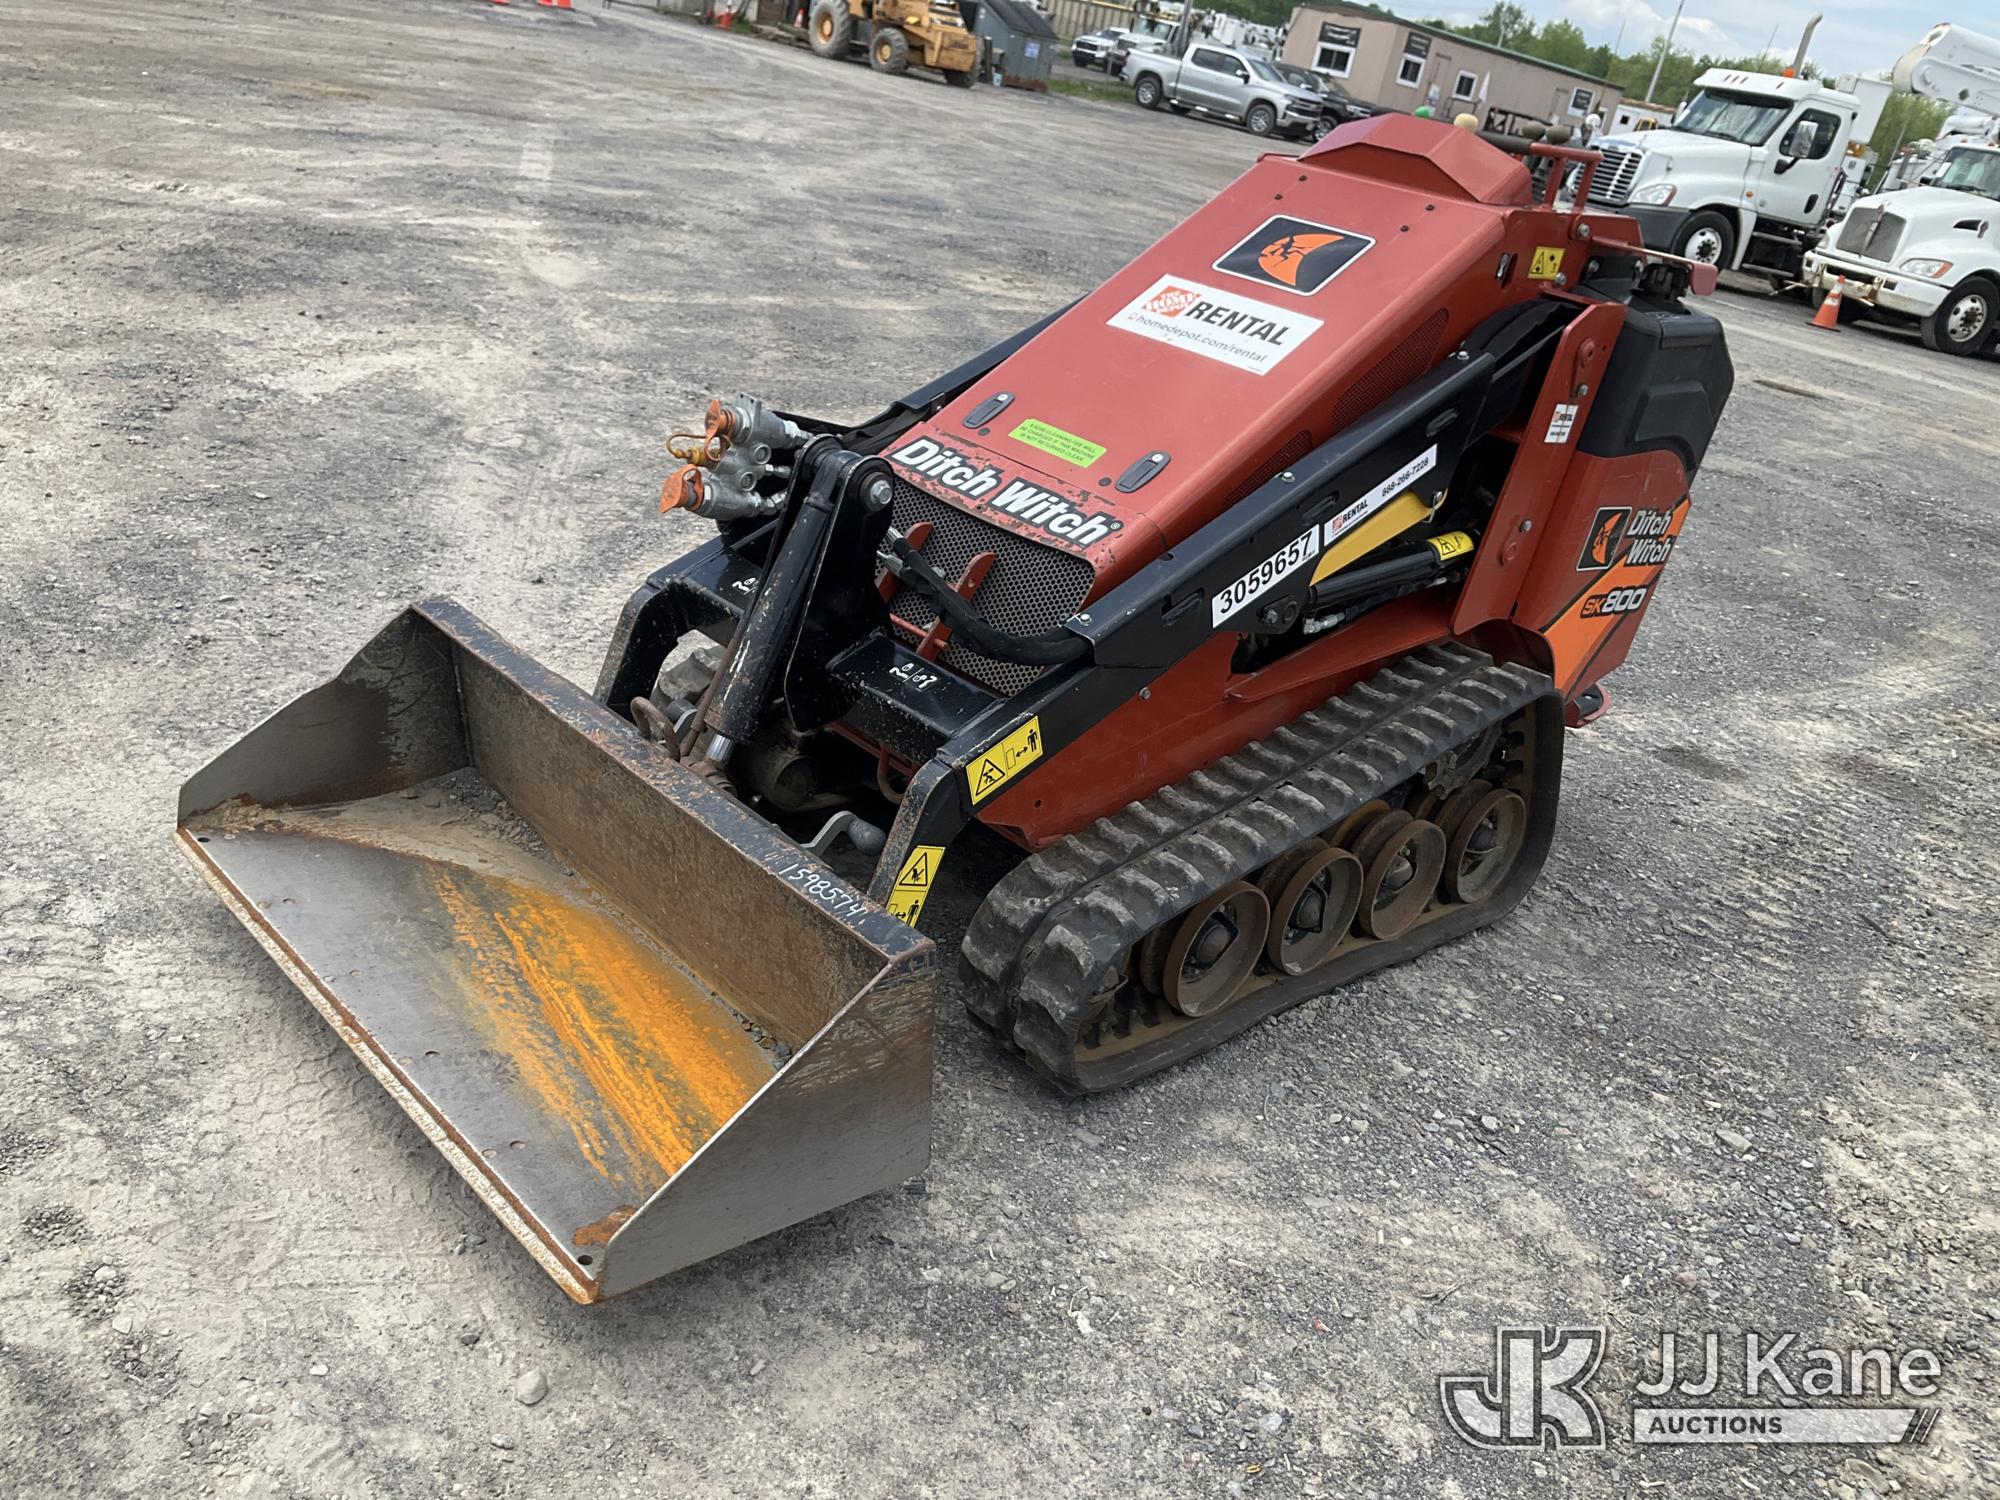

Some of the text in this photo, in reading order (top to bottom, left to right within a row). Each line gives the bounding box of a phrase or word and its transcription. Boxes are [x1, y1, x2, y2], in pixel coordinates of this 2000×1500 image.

[1136, 315, 1267, 363] homedepot.com/rental
[1185, 301, 1293, 347] RENTAL
[891, 438, 998, 498] Ditch
[1342, 499, 1368, 524] RENTAL
[1627, 510, 1672, 536] Ditch
[1220, 530, 1312, 614] 3059657
[1626, 538, 1672, 564] Witch
[1581, 588, 1647, 615] SK800
[778, 863, 868, 917] 1598574
